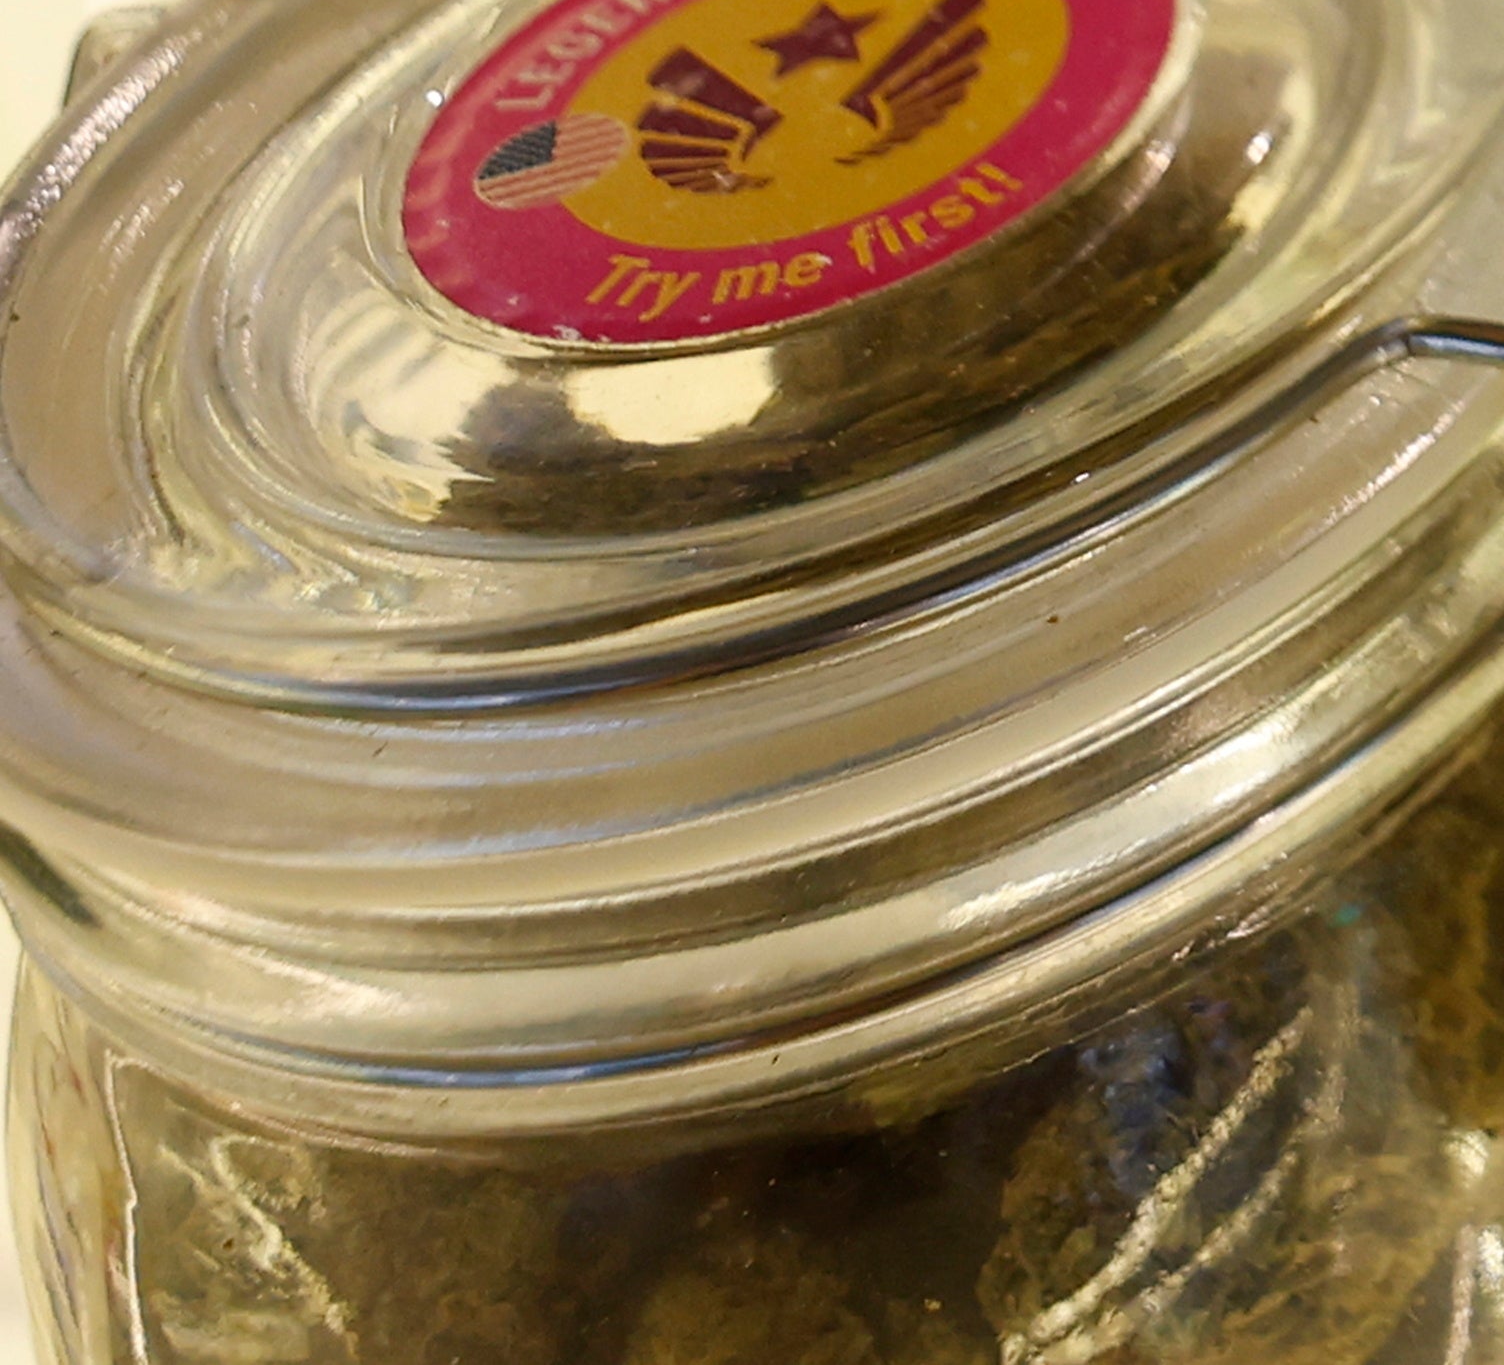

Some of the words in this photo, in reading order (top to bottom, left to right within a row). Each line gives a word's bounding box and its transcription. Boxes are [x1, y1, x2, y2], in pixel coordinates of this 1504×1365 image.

[585, 254, 701, 323] Try
[711, 252, 831, 305] me
[846, 162, 1023, 272] first!
